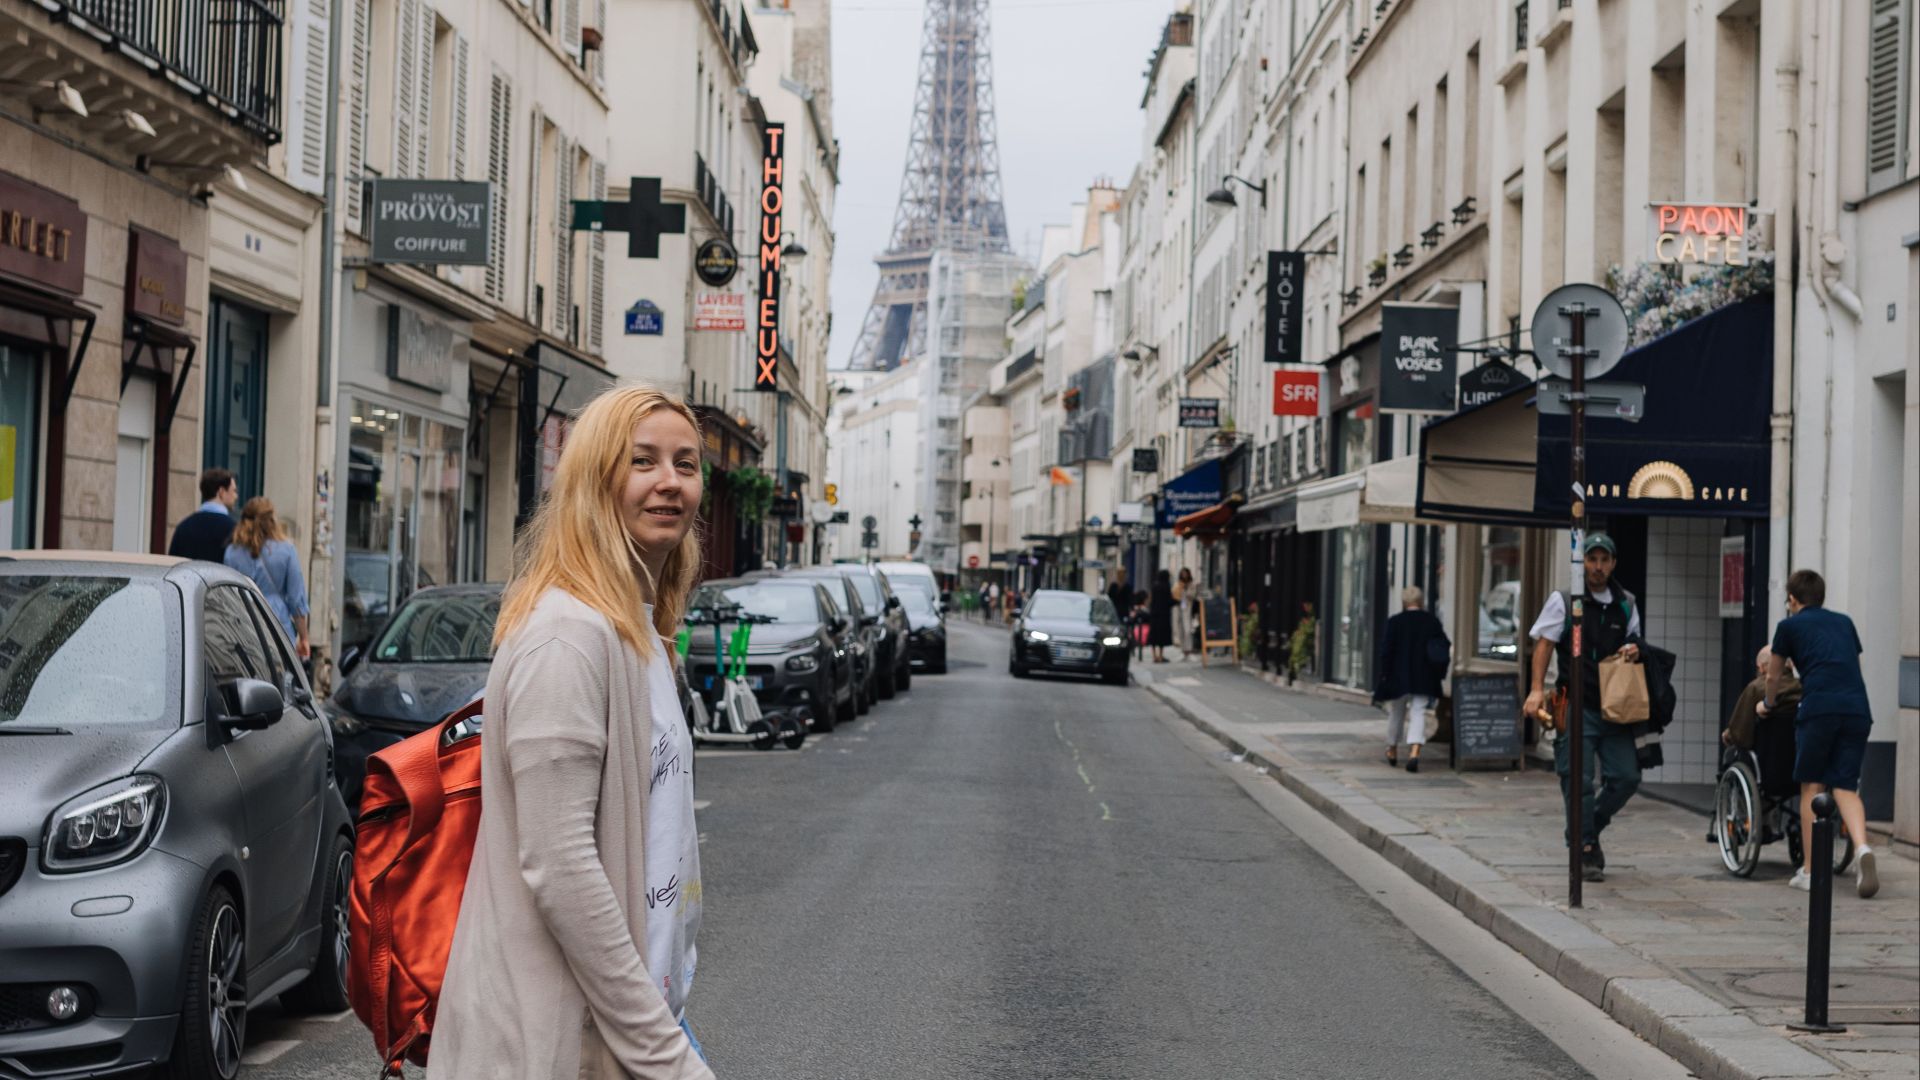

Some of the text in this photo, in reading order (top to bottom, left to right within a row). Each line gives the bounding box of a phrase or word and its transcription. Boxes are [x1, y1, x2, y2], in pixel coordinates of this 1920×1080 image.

[380, 200, 484, 223] PROVOST
[1660, 205, 1744, 235] PAON
[0, 208, 72, 263] RLET
[394, 236, 467, 253] COIFFURE
[757, 128, 783, 385] THOUMIEUX
[1656, 233, 1745, 266] CAFE
[697, 293, 745, 306] LAVERIE
[1277, 260, 1293, 354] HÔTEL
[1400, 336, 1440, 352] BLANC
[1395, 357, 1443, 372] VOSGES
[1282, 383, 1317, 402] SFR
[1586, 484, 1749, 502] AON CAFE
